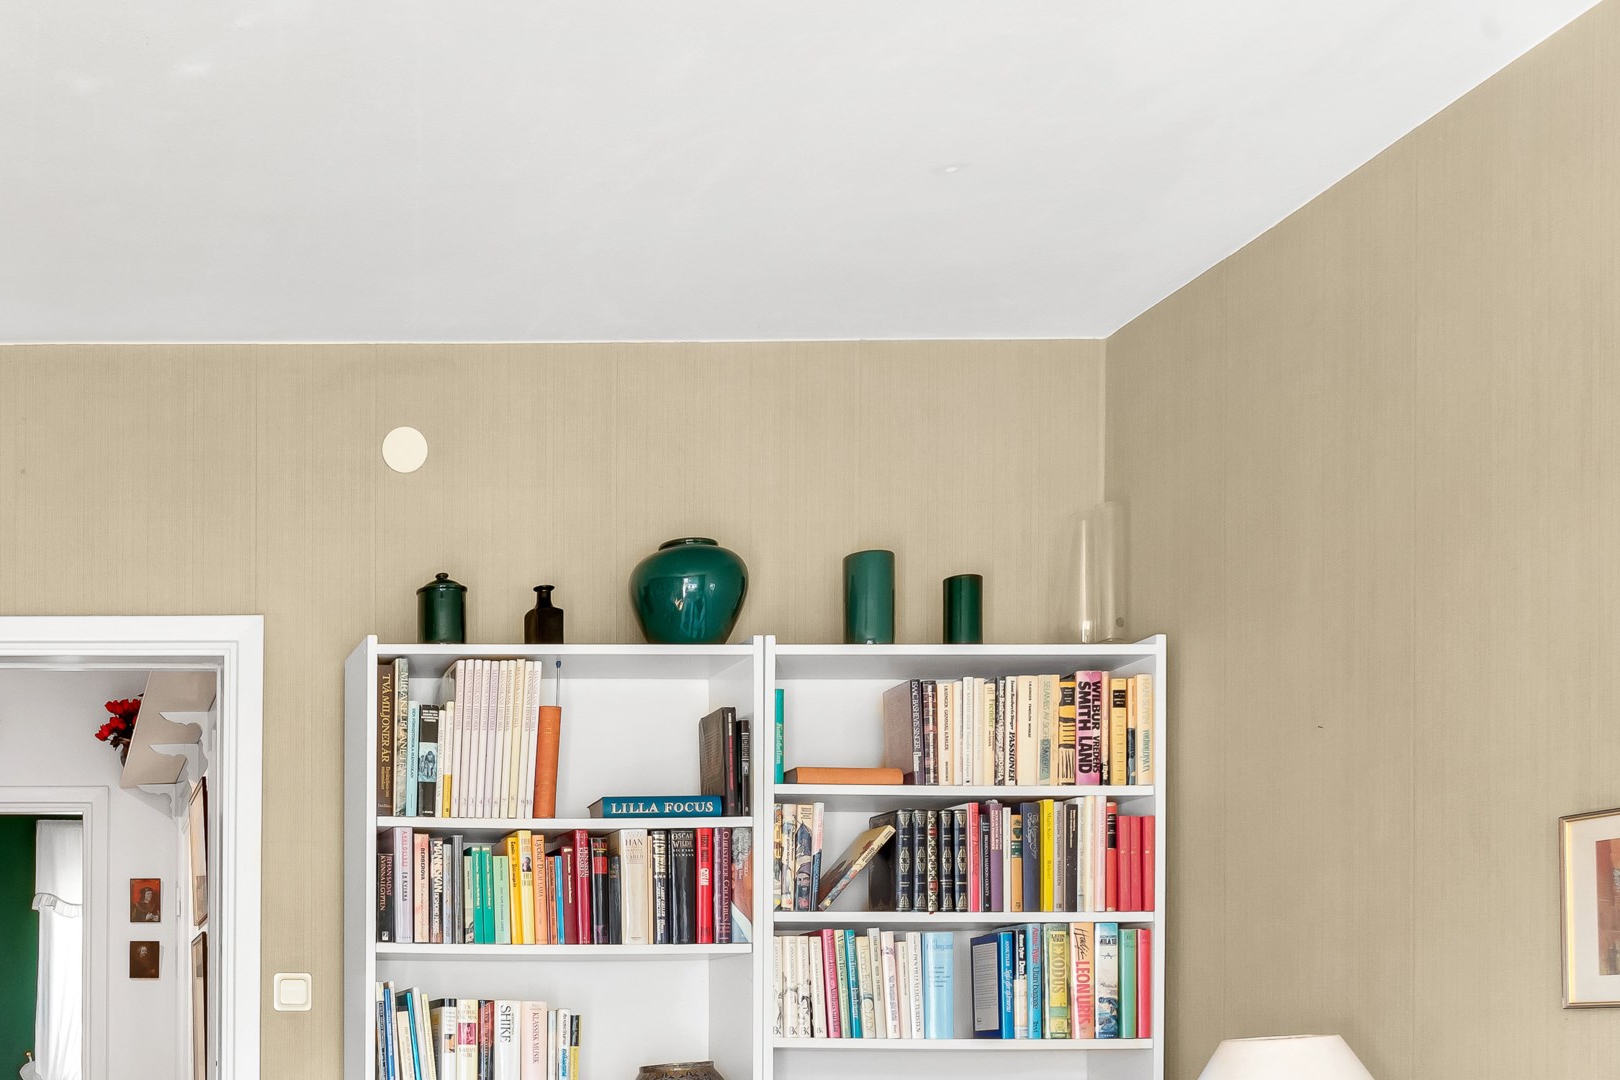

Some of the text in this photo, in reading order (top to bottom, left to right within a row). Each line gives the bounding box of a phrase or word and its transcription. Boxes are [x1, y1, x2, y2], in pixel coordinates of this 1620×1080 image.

[381, 674, 392, 694] TVÅ
[381, 695, 391, 741] MILJONER
[1078, 681, 1091, 731] SMITH
[1092, 681, 1101, 730] WILBUR
[381, 742, 391, 762] ÅR
[1078, 736, 1092, 774] LAND
[1092, 735, 1100, 774] VREDENS
[610, 802, 714, 814] LILLA FOCUS
[1052, 944, 1065, 993] EXODUS
[1076, 961, 1090, 1024] LEON URIS
